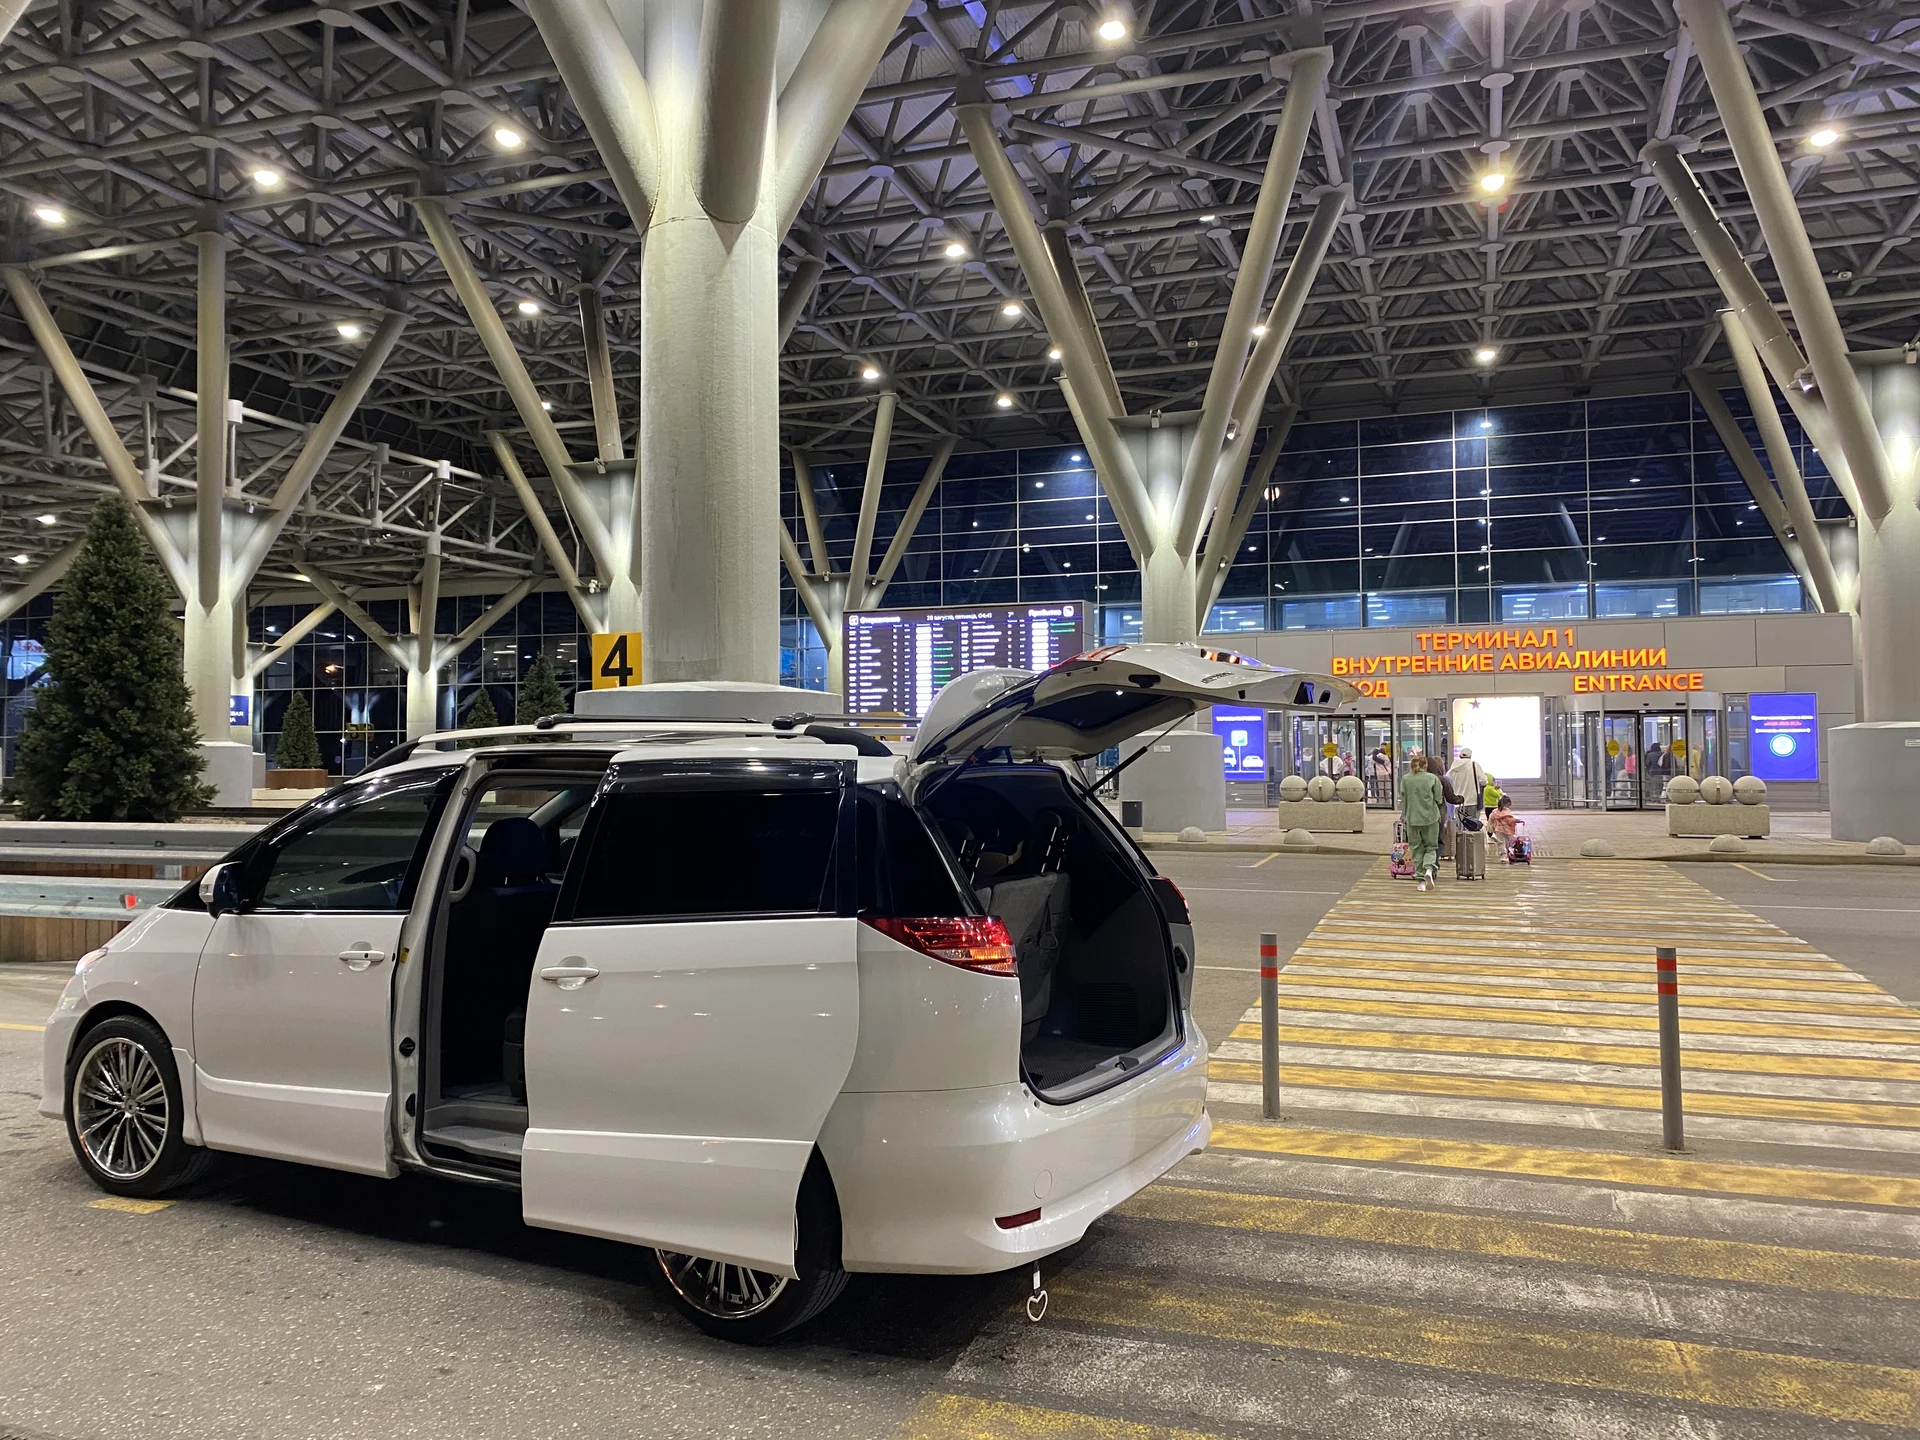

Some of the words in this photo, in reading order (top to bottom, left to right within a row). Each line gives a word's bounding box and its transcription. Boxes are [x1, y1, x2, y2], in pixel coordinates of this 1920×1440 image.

[1416, 629, 1558, 652] ТЕРМИНАЛ
[1564, 628, 1574, 647] 1
[601, 635, 633, 686] 4
[1332, 653, 1494, 675] ВНУТРЕННИЕ
[1500, 649, 1666, 672] АВИАЛИНИИ
[1352, 678, 1390, 699] ОД
[1574, 672, 1703, 692] ENTRANCE
